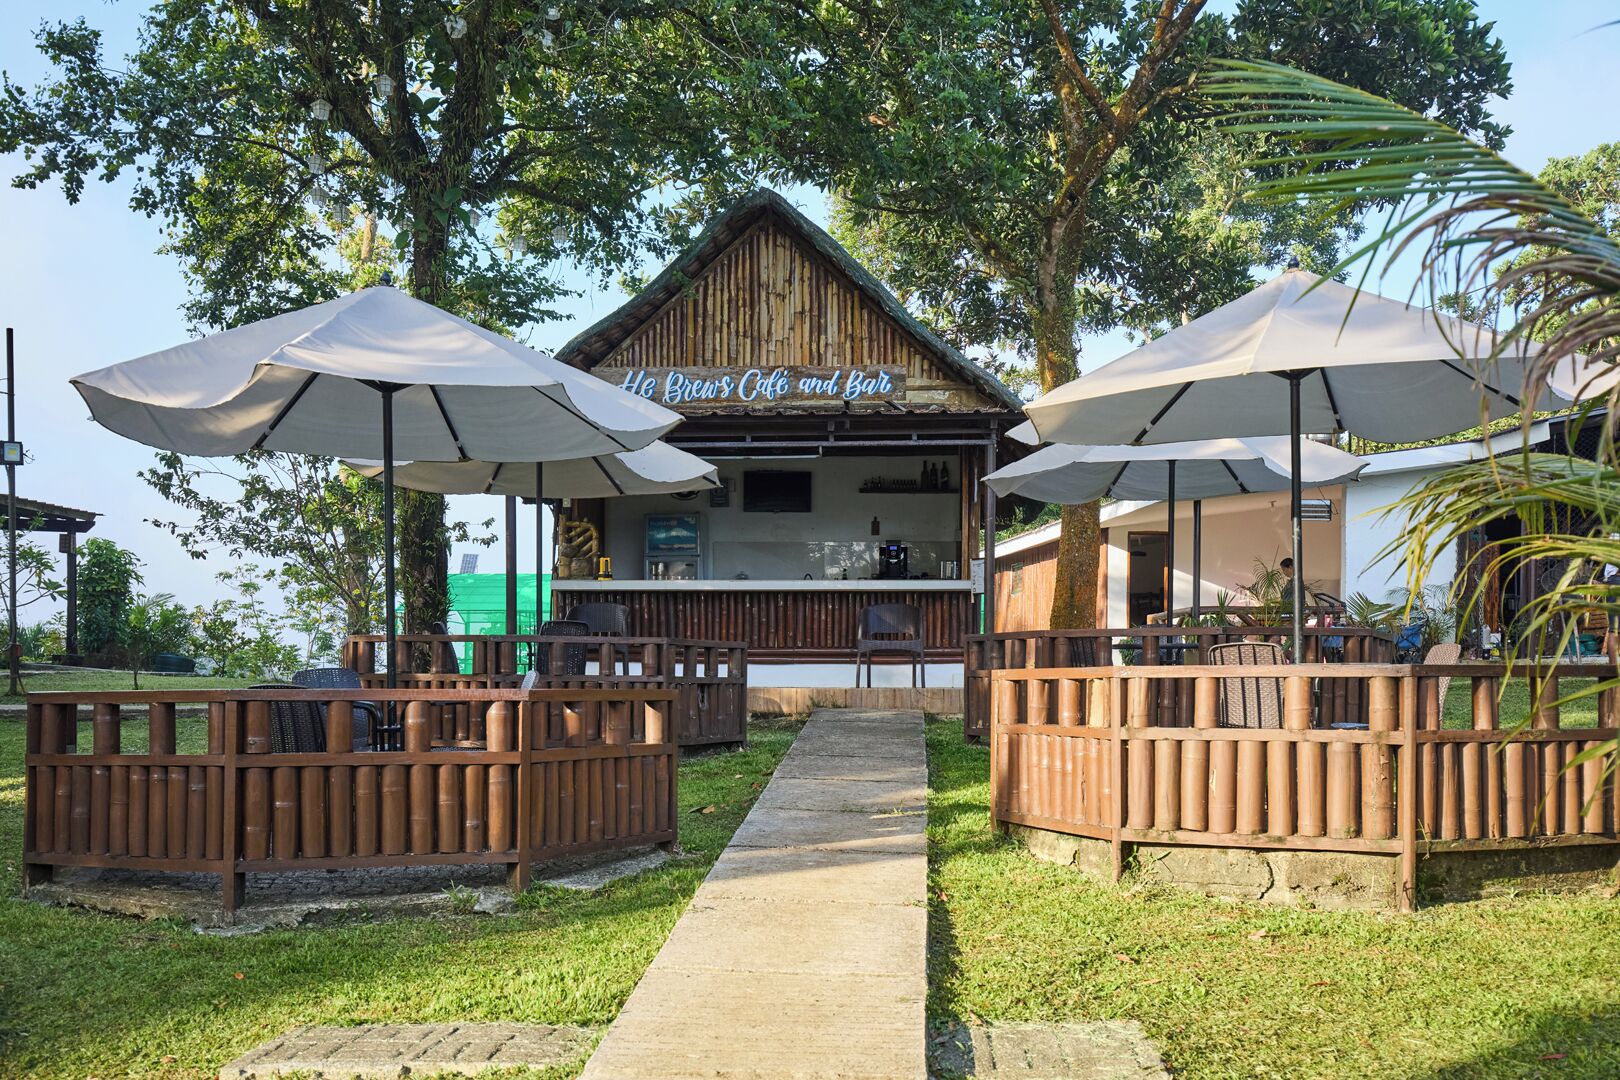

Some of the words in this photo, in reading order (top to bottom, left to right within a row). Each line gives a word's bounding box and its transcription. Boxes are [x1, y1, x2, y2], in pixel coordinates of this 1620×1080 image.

[617, 370, 656, 399] He
[662, 371, 736, 404] Brews
[738, 369, 789, 401] Café
[799, 370, 842, 395] and
[843, 369, 893, 400] Bar
